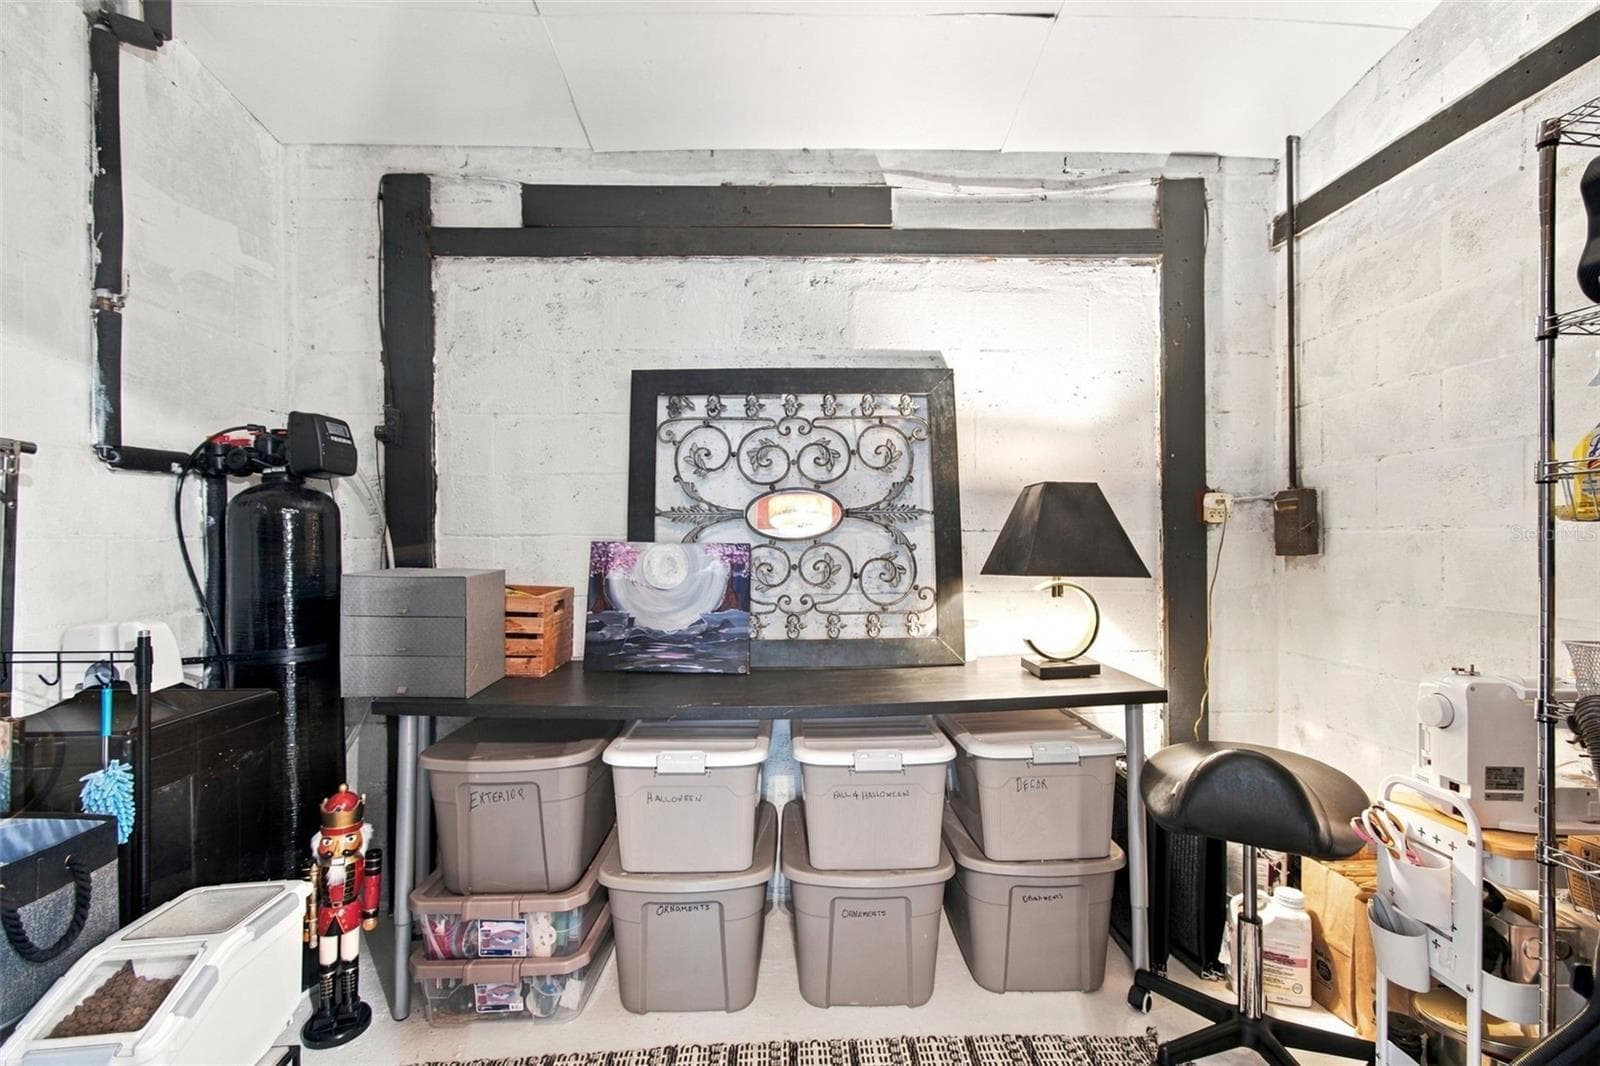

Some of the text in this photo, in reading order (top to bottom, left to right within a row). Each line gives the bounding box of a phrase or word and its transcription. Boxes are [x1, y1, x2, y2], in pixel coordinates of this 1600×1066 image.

[1016, 777, 1049, 792] DECOR
[469, 788, 525, 812] EXTERIOR
[646, 791, 703, 804] HALLOWEEN
[861, 790, 909, 800] HALLOWEEN
[656, 904, 711, 916] ORNAMENTS
